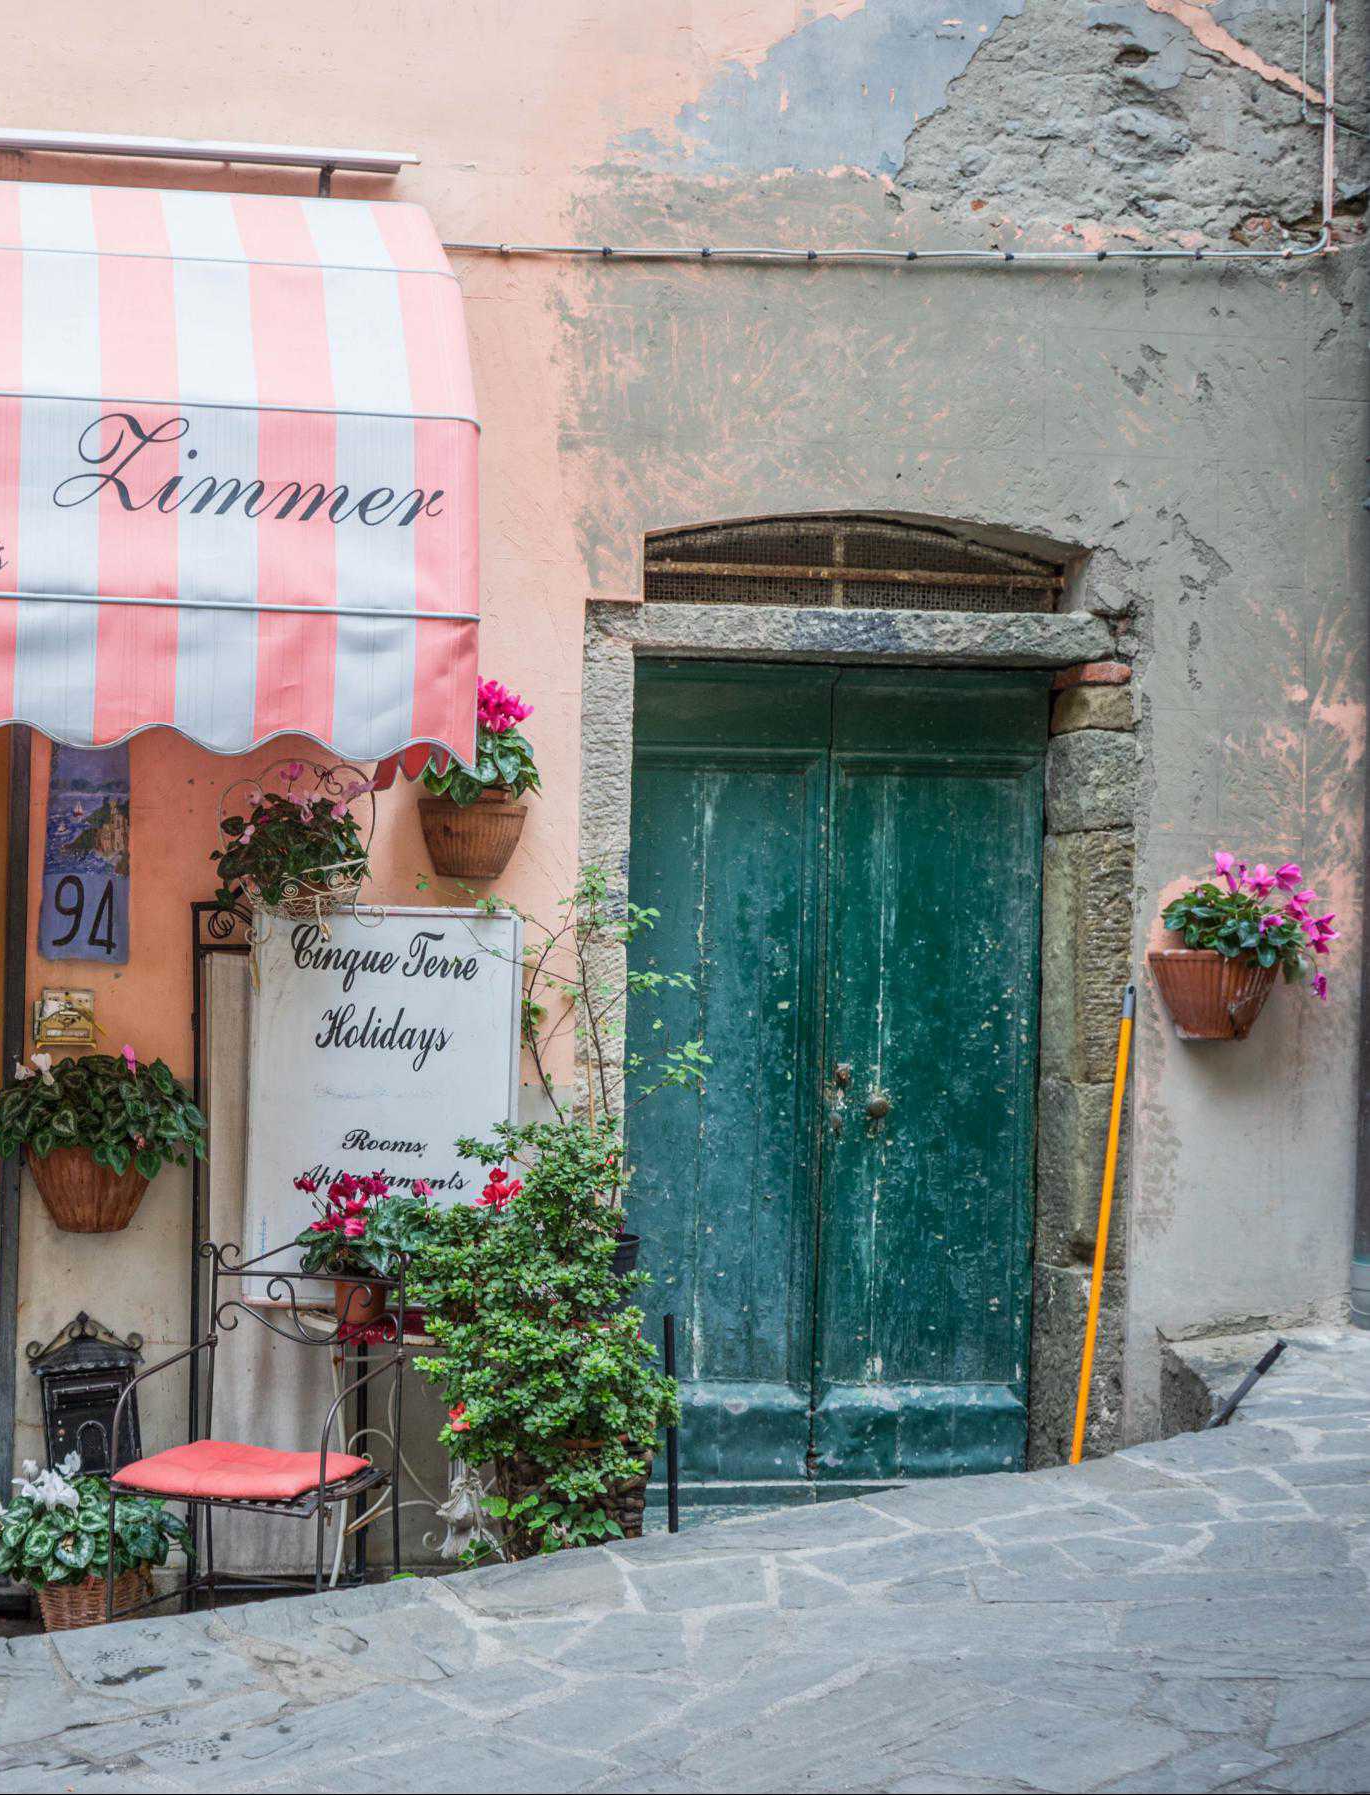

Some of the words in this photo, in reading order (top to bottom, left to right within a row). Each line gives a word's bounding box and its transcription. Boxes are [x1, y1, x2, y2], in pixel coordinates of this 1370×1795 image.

[53, 413, 444, 527] Zimmer
[52, 874, 117, 955] 94
[291, 924, 399, 992] Cinque
[402, 932, 479, 980] Terre
[315, 1003, 454, 1072] Holidays
